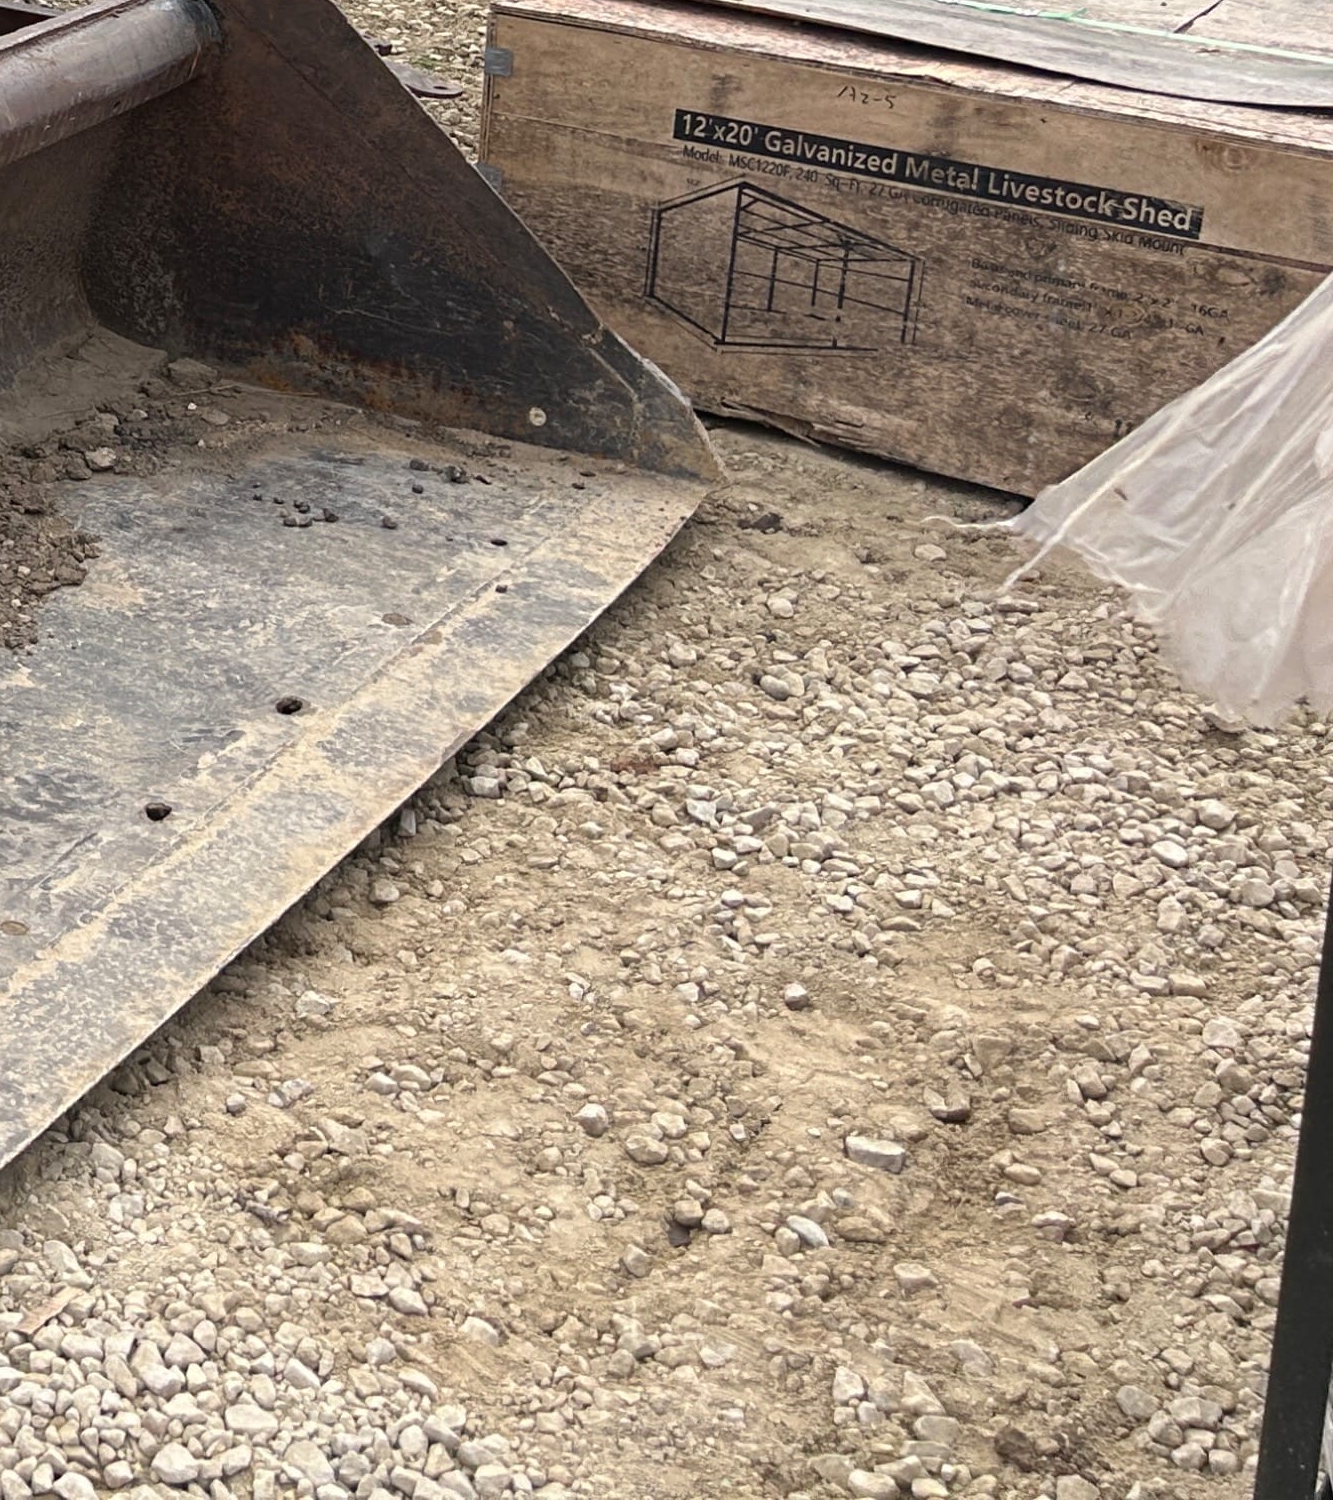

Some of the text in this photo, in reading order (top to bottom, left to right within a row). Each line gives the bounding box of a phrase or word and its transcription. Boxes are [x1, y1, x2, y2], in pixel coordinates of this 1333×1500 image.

[683, 113, 1192, 231] 12'x20' Galvanized Metal Livestock Shed
[795, 167, 818, 183] 240
